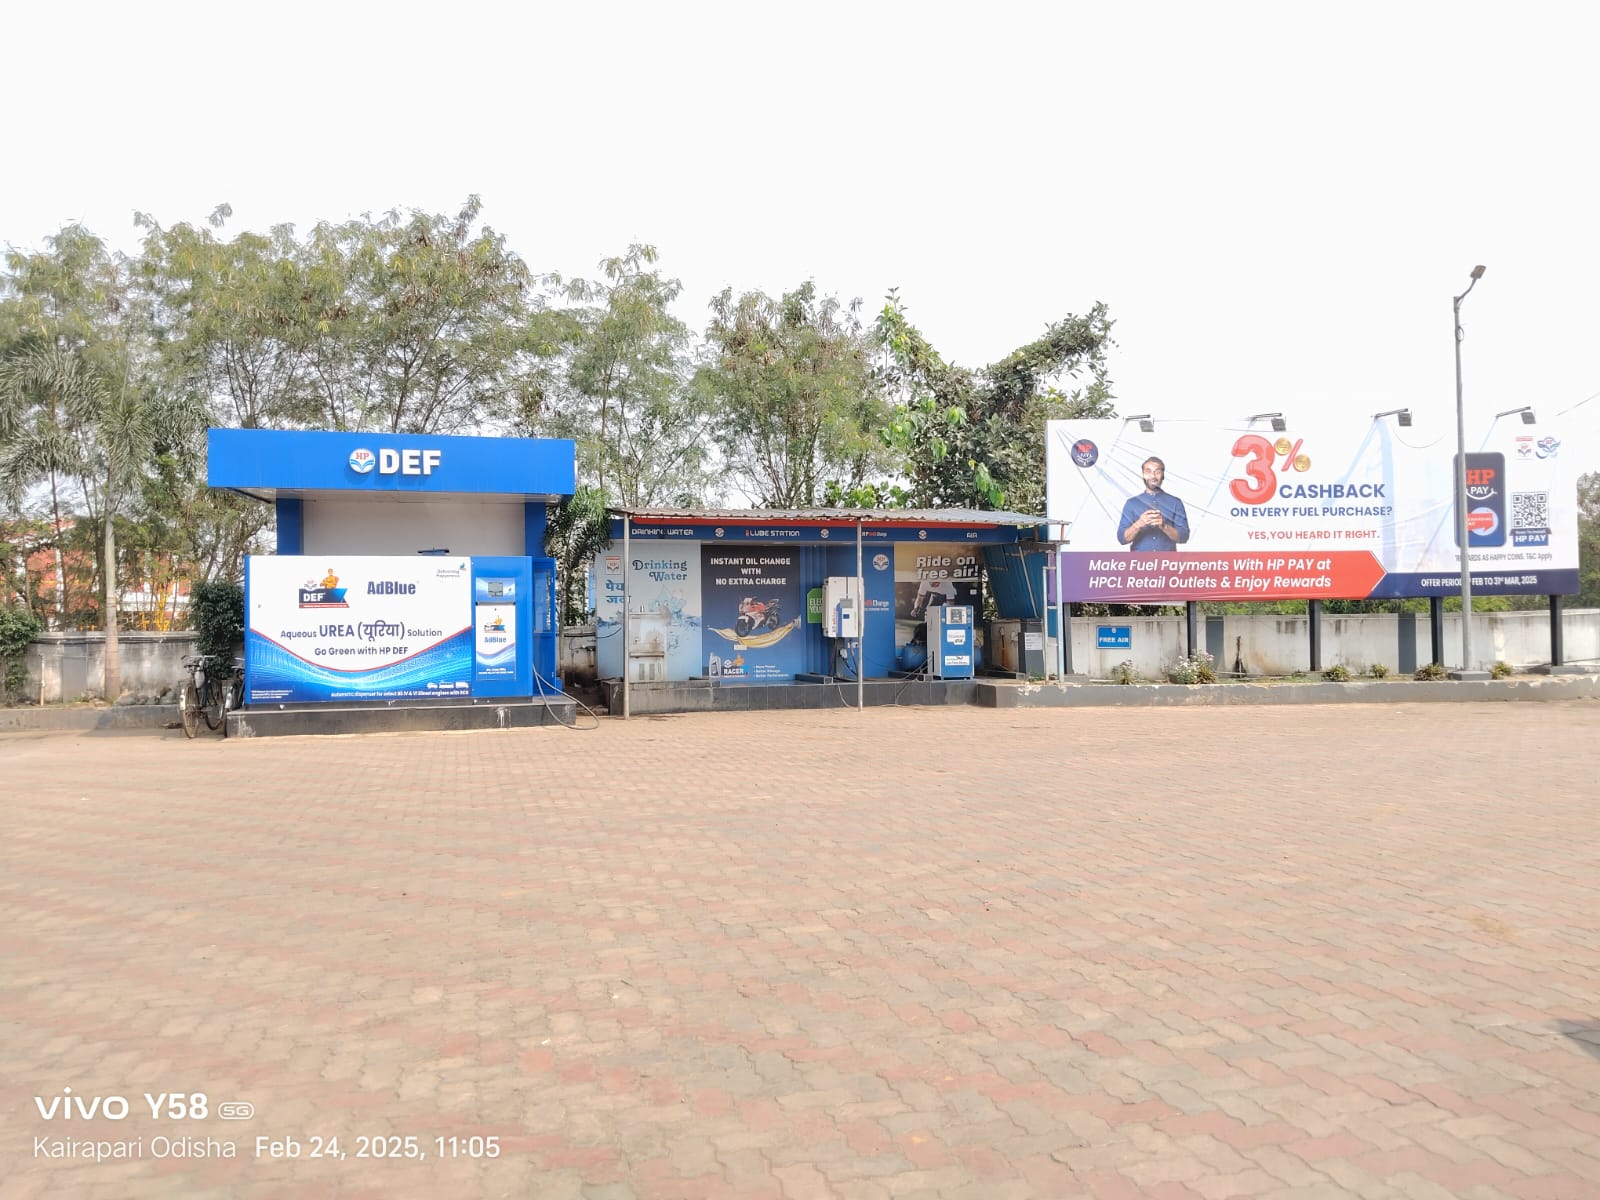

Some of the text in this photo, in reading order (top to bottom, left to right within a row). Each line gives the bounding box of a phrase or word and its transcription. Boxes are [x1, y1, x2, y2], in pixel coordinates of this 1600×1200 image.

[355, 452, 370, 460] HP
[379, 448, 441, 475] DEF
[1466, 469, 1495, 485] HP
[1279, 484, 1385, 499] CASHBACK
[1470, 486, 1489, 495] PAY
[1230, 506, 1393, 517] ON EVERY FUEL PURCHASE?
[1295, 530, 1331, 539] HEARD
[1333, 530, 1342, 539] IT
[1345, 530, 1380, 539] RIGHT.
[1529, 534, 1546, 542] PAY
[710, 557, 791, 565] INSTANT OIL CHANGE
[916, 555, 976, 568] Ride on
[1490, 553, 1506, 561] HAPPY
[632, 560, 688, 571] Drinking
[741, 567, 761, 575] WITH
[1089, 558, 1332, 575] Make Fuel Payments With HP PAY at
[649, 571, 688, 582] Water
[917, 565, 979, 580] free air!
[755, 577, 787, 585] CHARGE
[1089, 575, 1331, 591] HPCL Retail Outlets & Enjoy Rewards
[1421, 578, 1441, 587] OFFER
[1472, 577, 1484, 586] FEB
[1484, 577, 1493, 586] TO
[1521, 575, 1538, 584] 2025
[367, 580, 417, 595] AdBlue
[303, 593, 324, 602] DEF
[280, 629, 317, 640] Aqueous
[319, 624, 355, 638] UREA
[407, 629, 443, 637] Solution
[314, 646, 408, 656] Go Green with HP DEF
